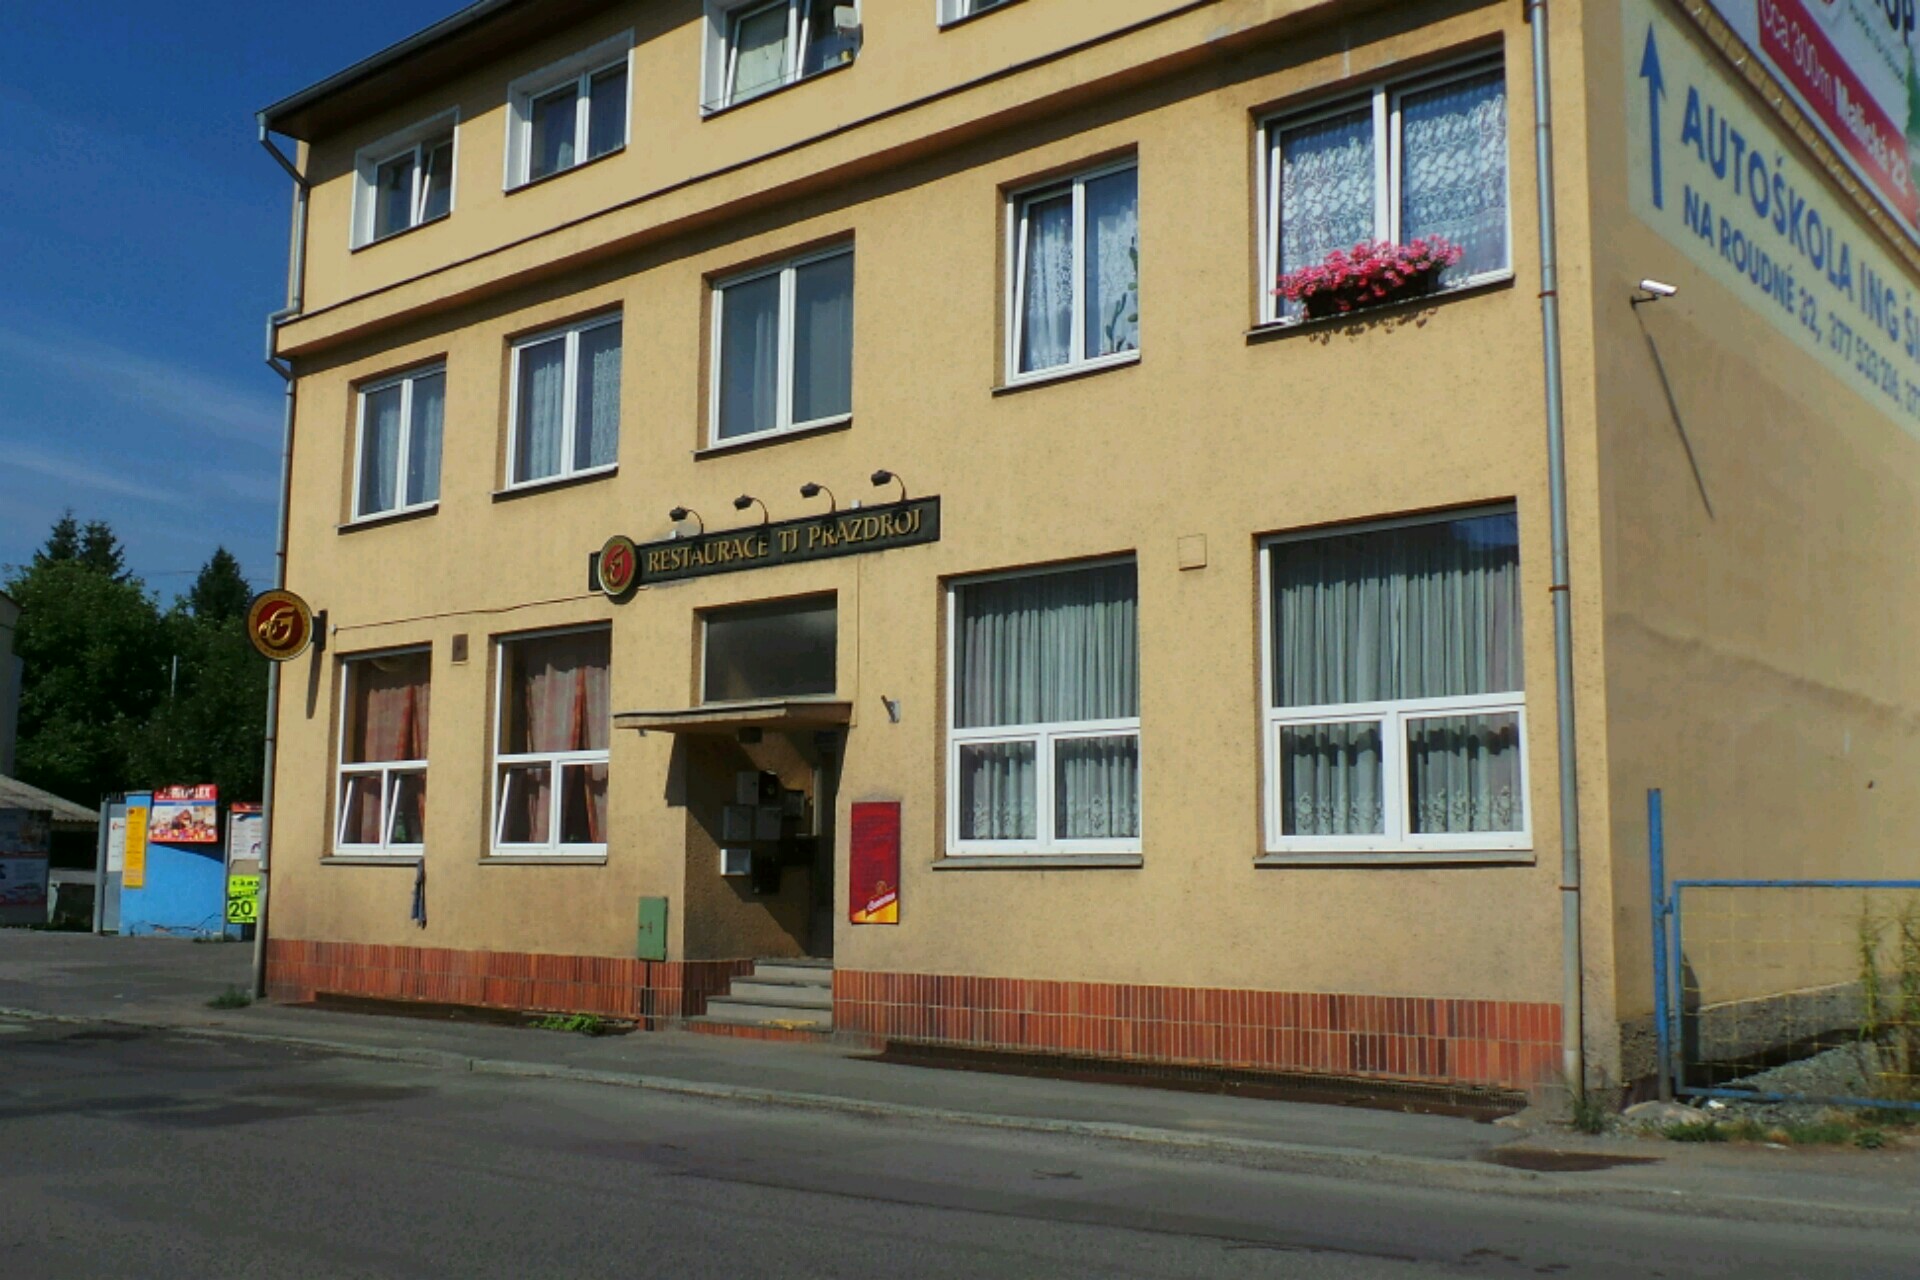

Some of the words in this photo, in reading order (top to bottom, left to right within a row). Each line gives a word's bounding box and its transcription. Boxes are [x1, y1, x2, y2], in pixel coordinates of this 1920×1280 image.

[1681, 85, 1854, 303] AUTOŠKOLA
[1684, 183, 1714, 247] NA
[1719, 215, 1795, 315] ROUDNÉ
[648, 535, 769, 573] RESTAURACE
[778, 528, 800, 553] TJ
[807, 508, 922, 549] PRAZDROJ
